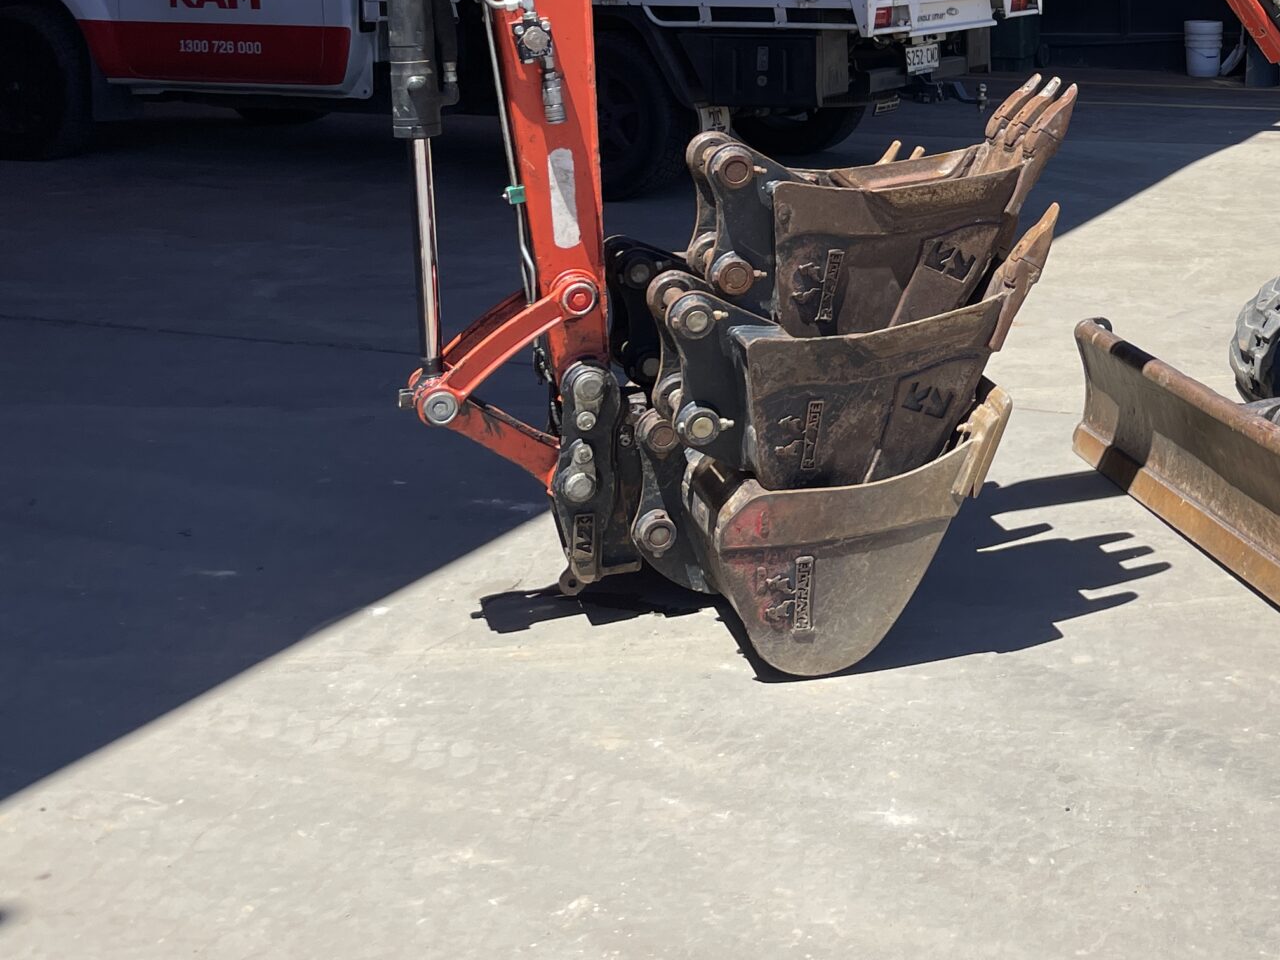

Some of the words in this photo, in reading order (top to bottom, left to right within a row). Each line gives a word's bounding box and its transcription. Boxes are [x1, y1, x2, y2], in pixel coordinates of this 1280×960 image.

[179, 40, 209, 53] 1300
[212, 40, 235, 54] 726
[237, 41, 263, 55] 000
